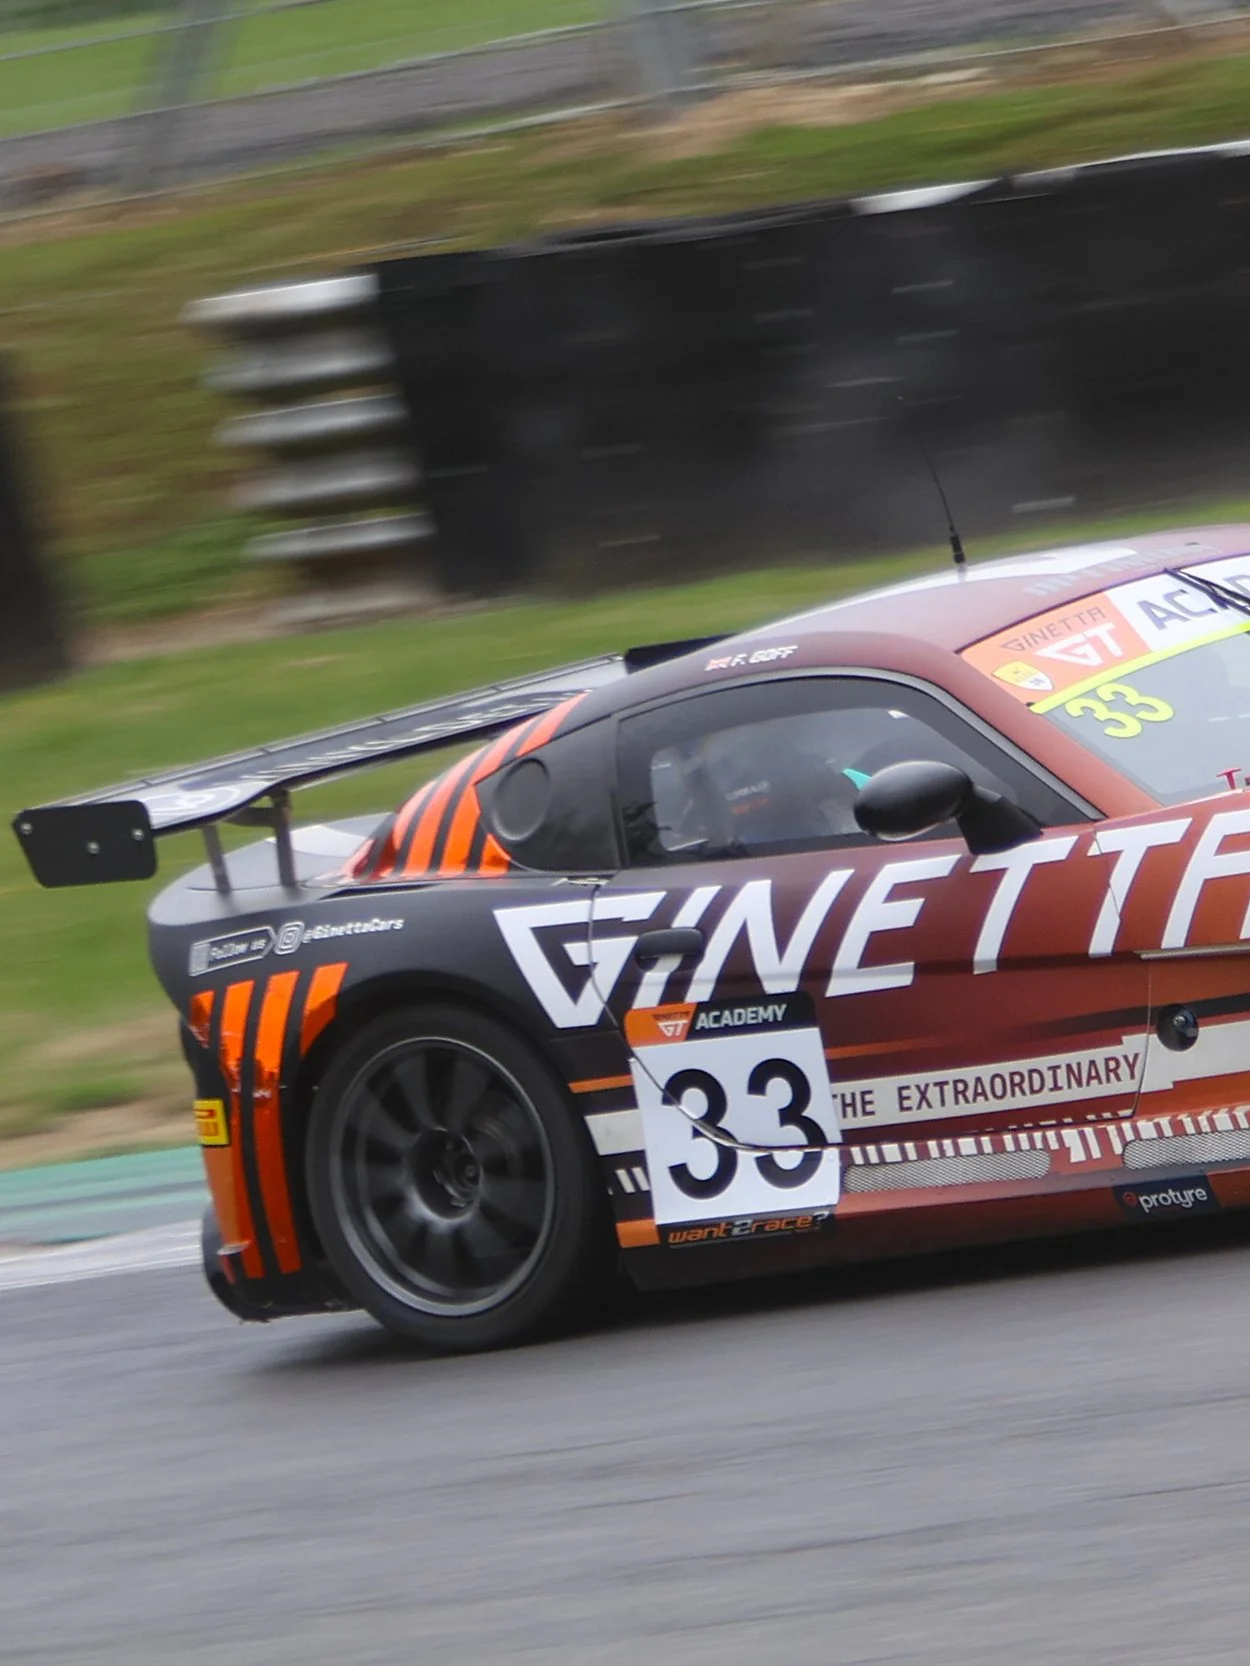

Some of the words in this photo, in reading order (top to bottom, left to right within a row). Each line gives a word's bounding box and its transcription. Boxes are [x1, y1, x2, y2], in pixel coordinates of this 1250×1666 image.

[999, 606, 1106, 652] GINETTA
[1031, 621, 1124, 667] GT
[1066, 683, 1174, 739] 33
[694, 1004, 787, 1031] ACADEMY
[897, 1052, 1141, 1112] EXTRAORDINARY
[661, 1057, 829, 1201] 33
[1138, 1187, 1208, 1213] protyre
